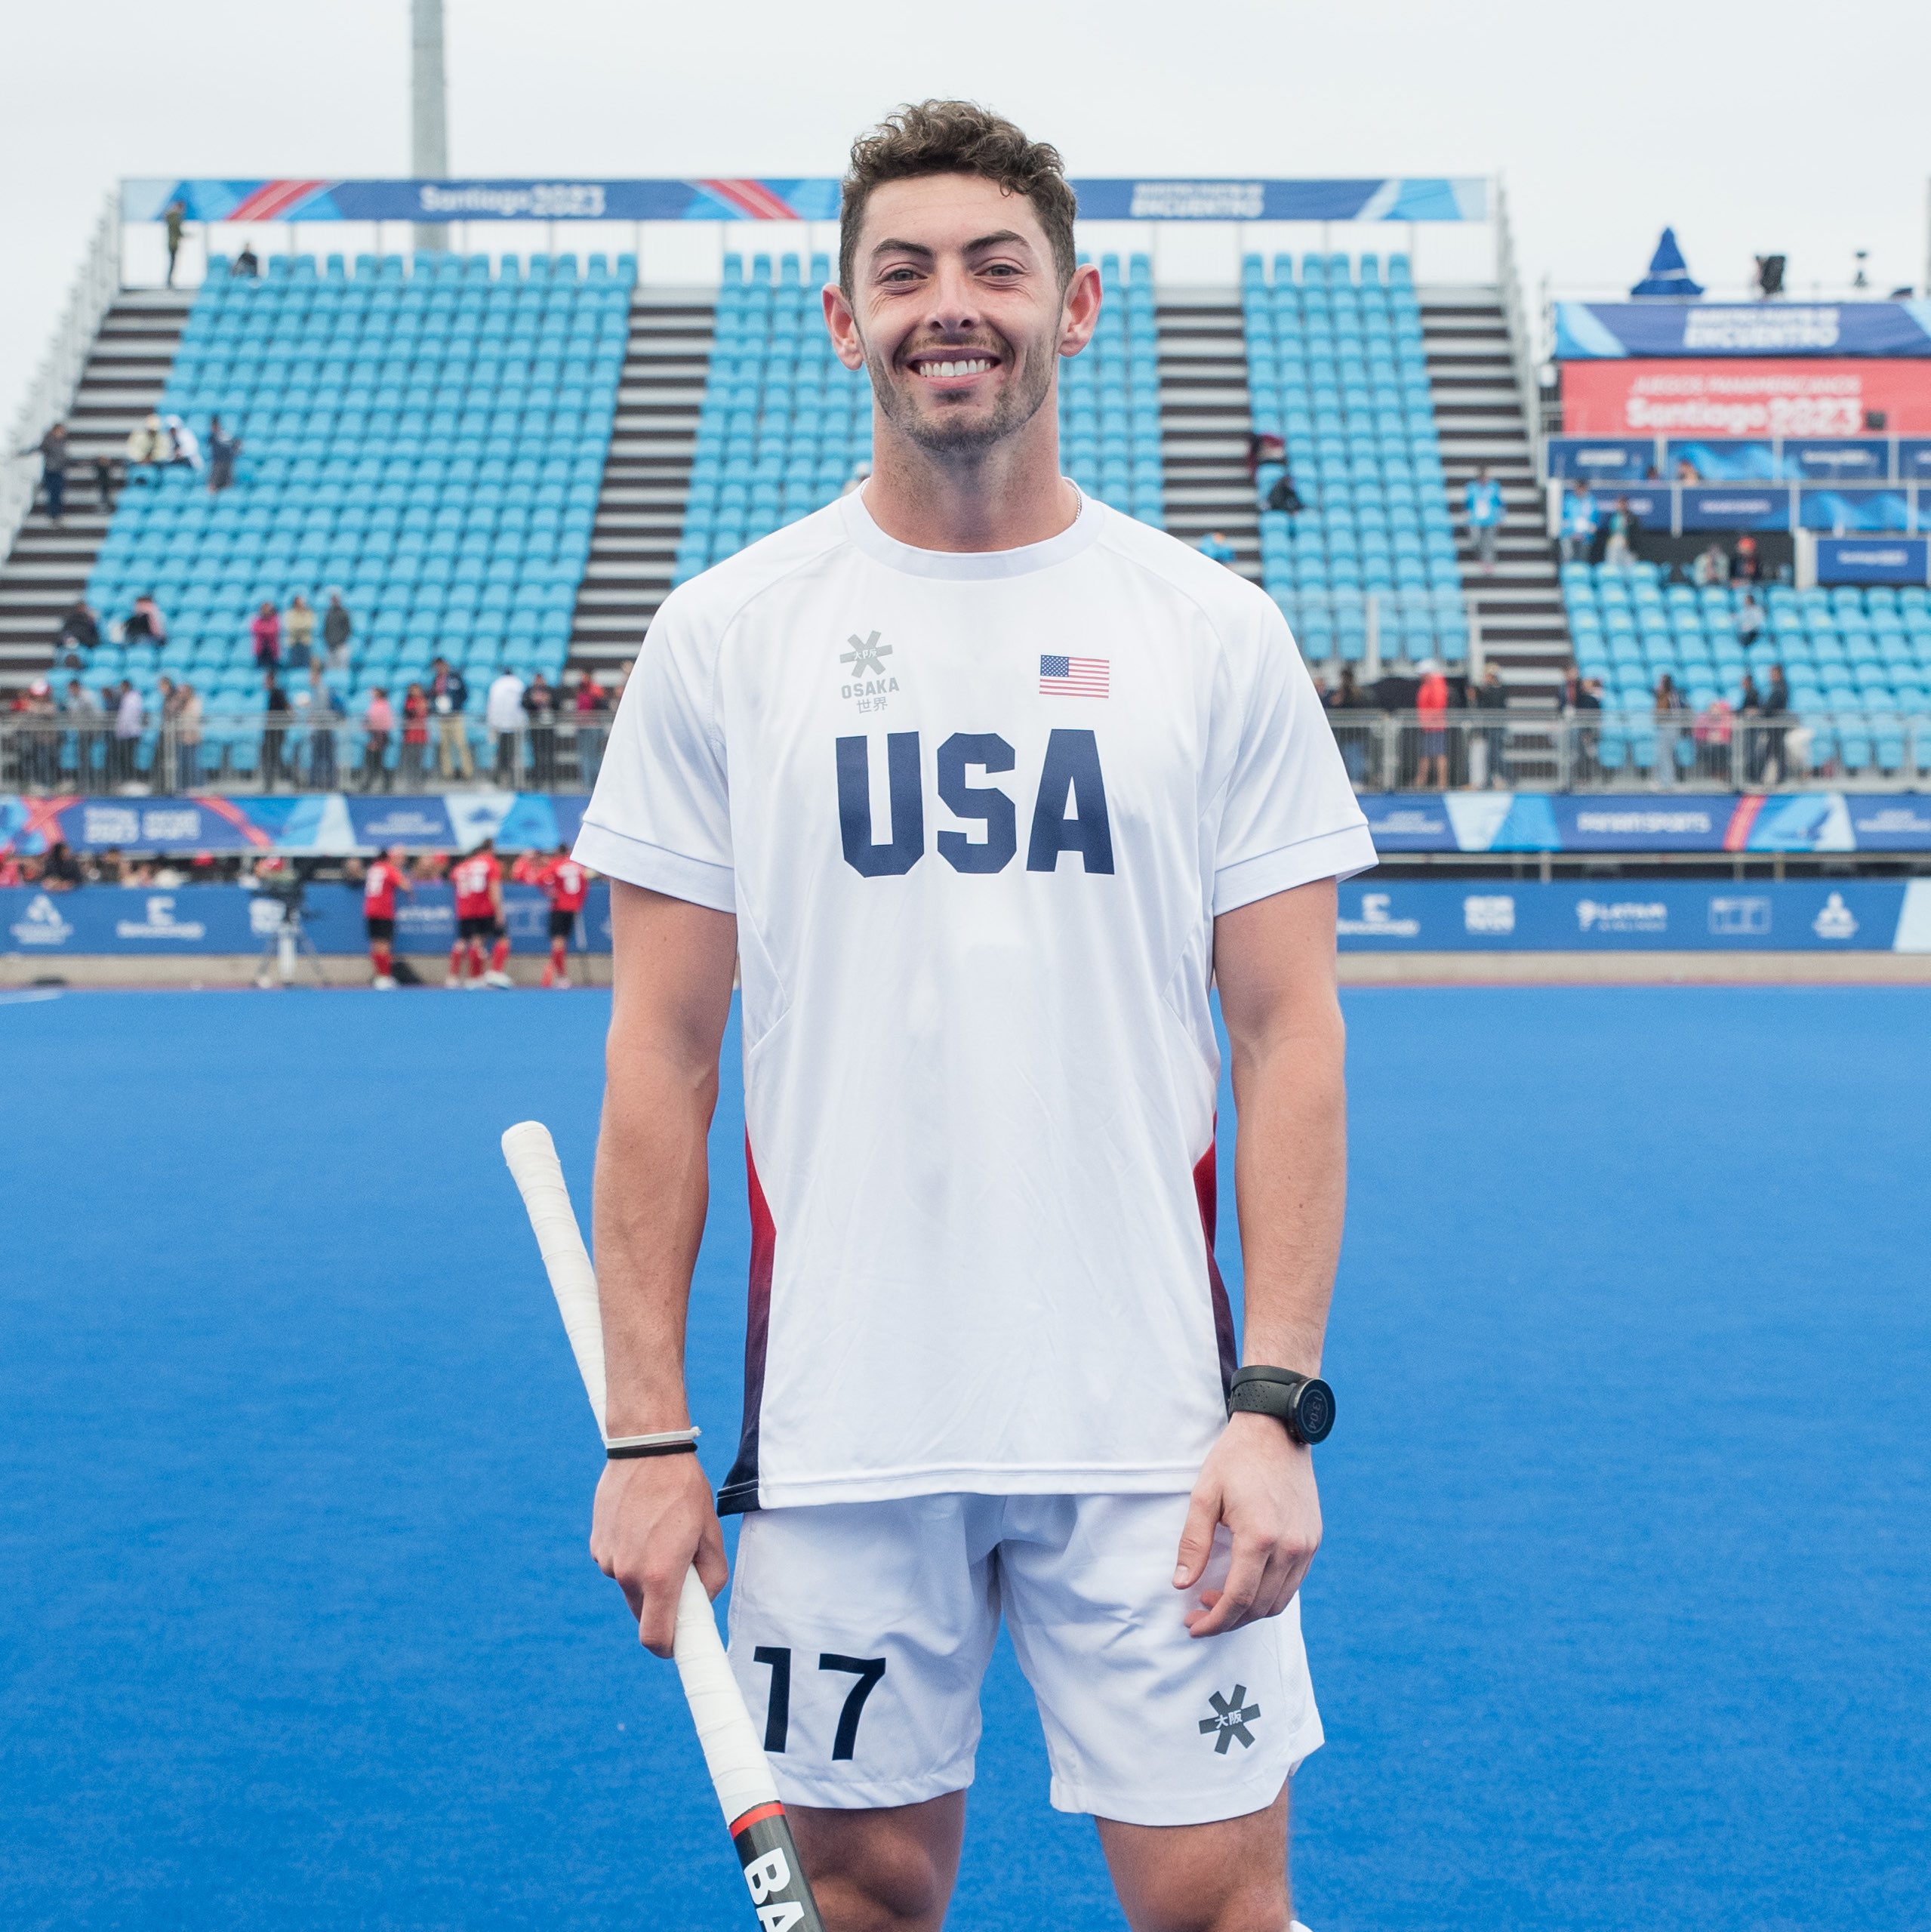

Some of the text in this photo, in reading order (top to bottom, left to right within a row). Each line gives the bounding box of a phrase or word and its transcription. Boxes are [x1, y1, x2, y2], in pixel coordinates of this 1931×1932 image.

[1627, 397, 1862, 436] Santiago 2023
[841, 676, 900, 699] OSAKA
[857, 696, 889, 713] 世界
[836, 729, 1115, 878] USA
[753, 1646, 886, 1761] 17
[1215, 1709, 1243, 1730] 大阪
